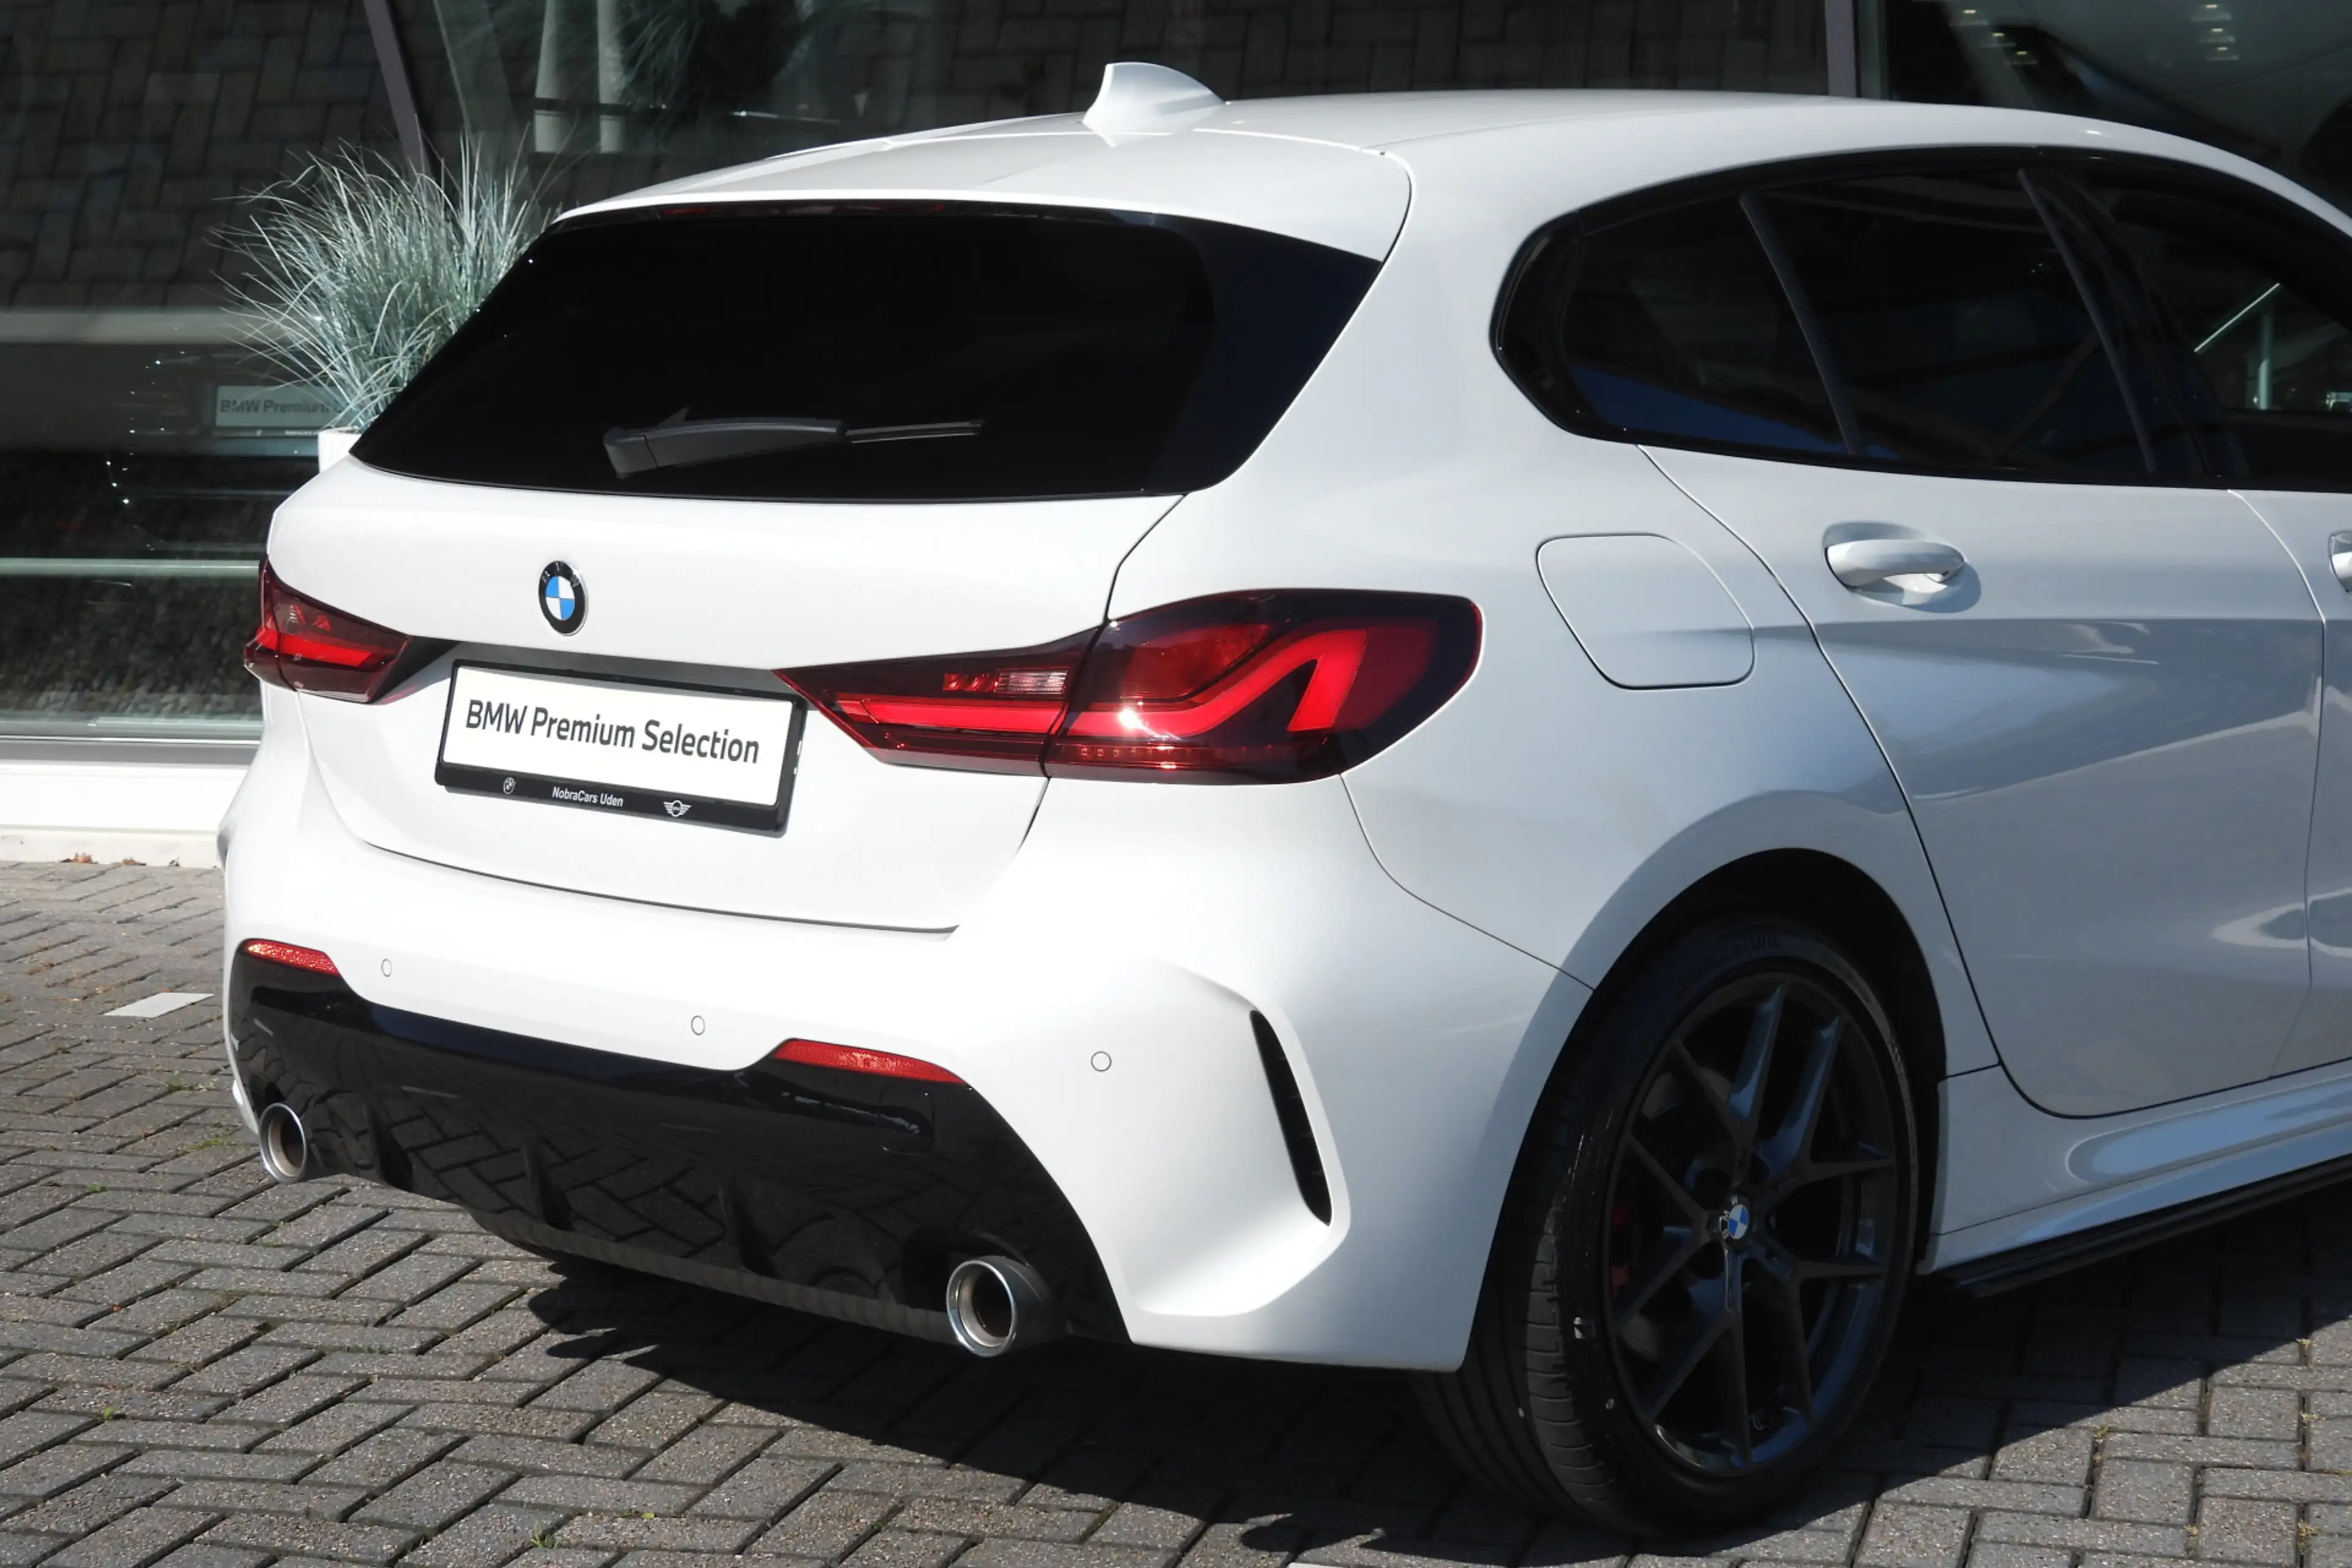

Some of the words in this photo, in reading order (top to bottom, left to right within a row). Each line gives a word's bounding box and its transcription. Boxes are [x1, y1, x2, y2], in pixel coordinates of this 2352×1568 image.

[220, 399, 260, 413] BMW
[466, 699, 528, 734] BMW
[530, 706, 635, 748] Premium
[642, 719, 760, 764] Selection
[552, 786, 598, 804] NobraCars
[600, 793, 624, 807] Uden
